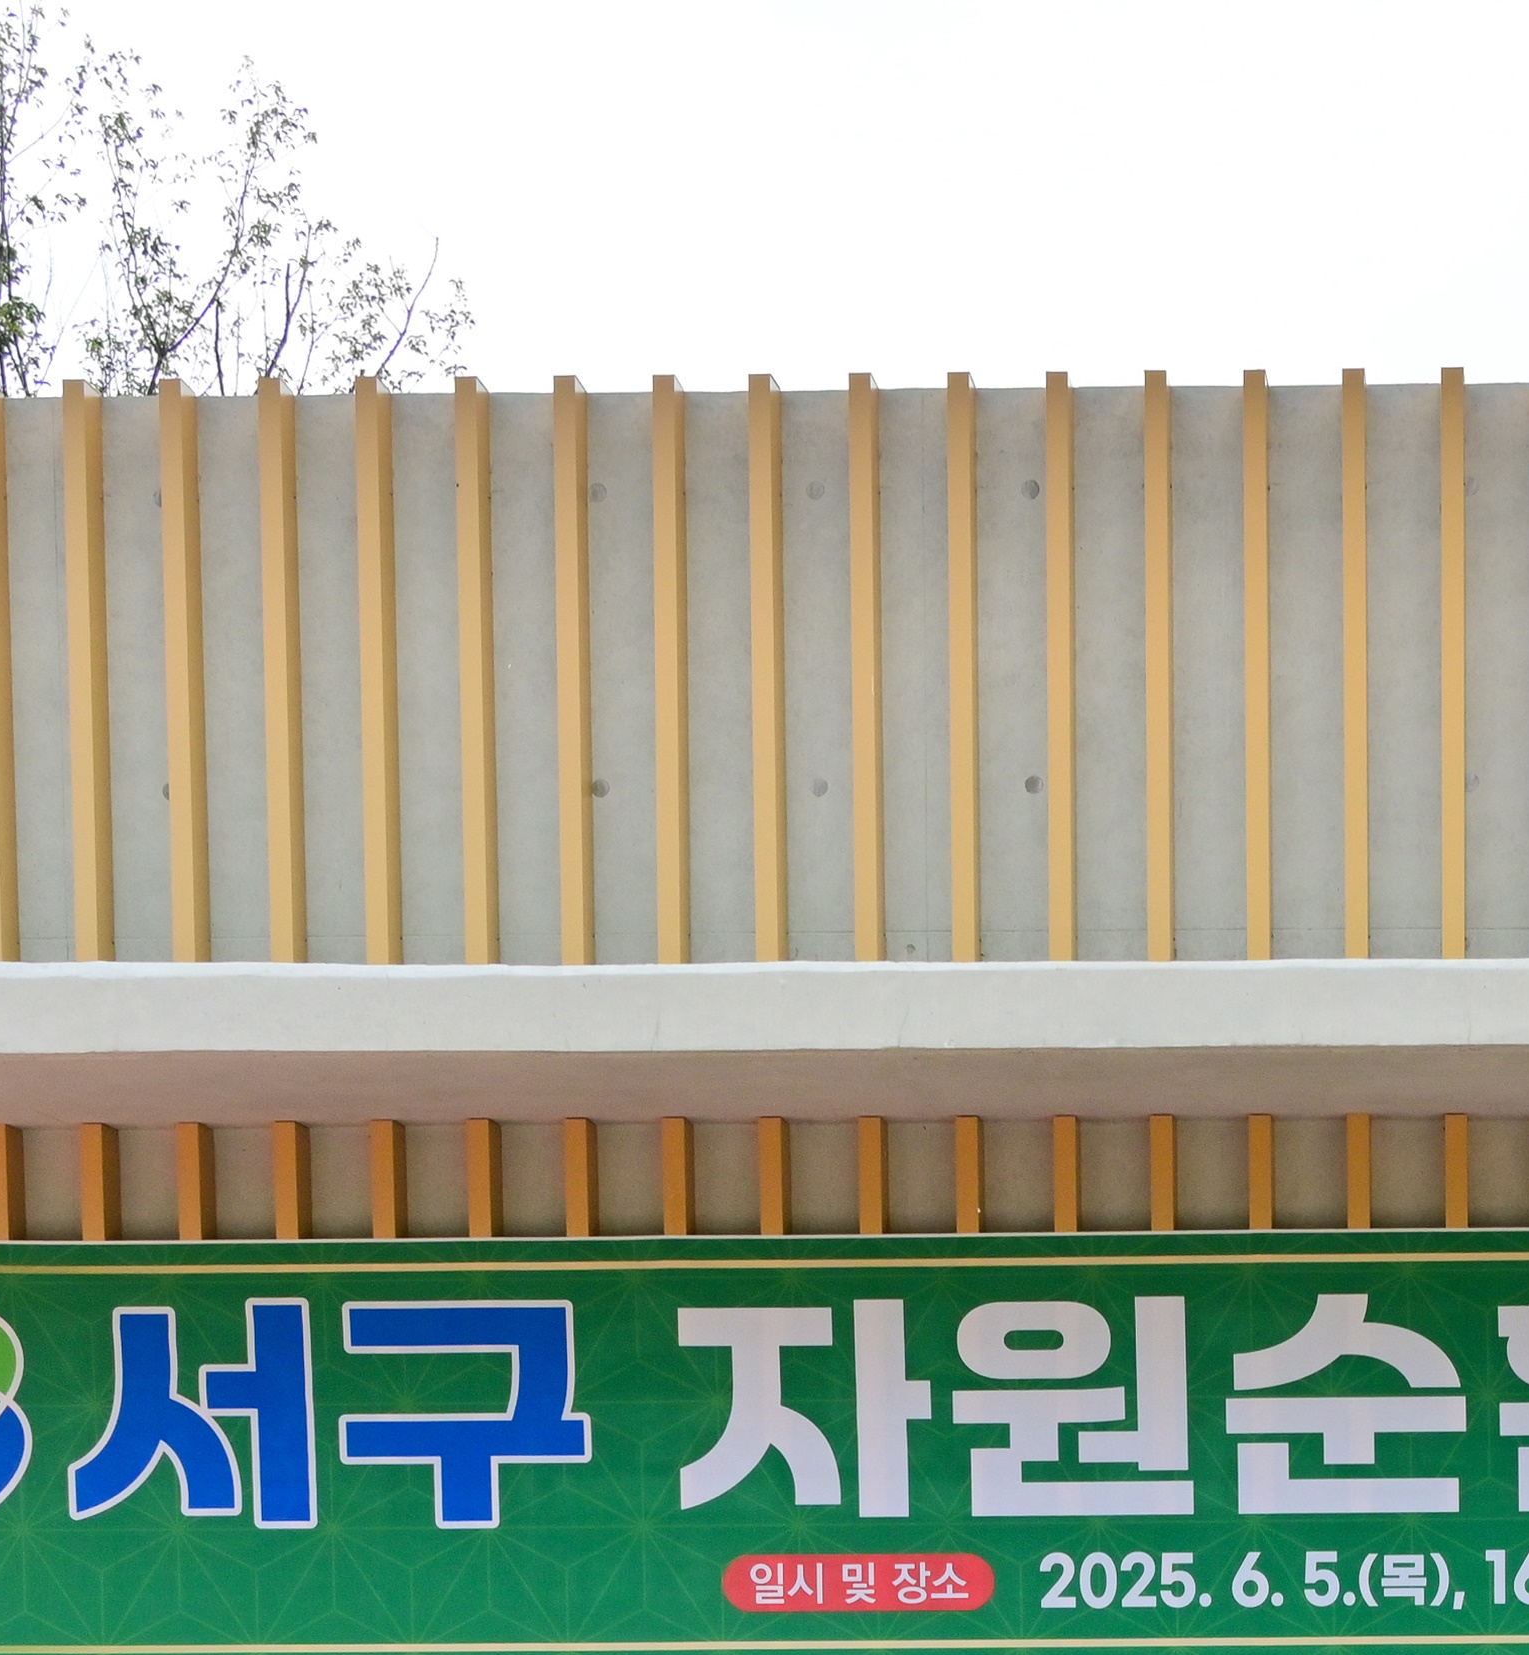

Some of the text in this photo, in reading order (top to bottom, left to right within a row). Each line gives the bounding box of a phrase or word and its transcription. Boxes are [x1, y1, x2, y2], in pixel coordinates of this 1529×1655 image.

[68, 1296, 594, 1529] 서구
[748, 1562, 824, 1605] 일시
[839, 1561, 876, 1604] 및
[891, 1561, 970, 1603] 장소
[1038, 1551, 1212, 1609] 2025.
